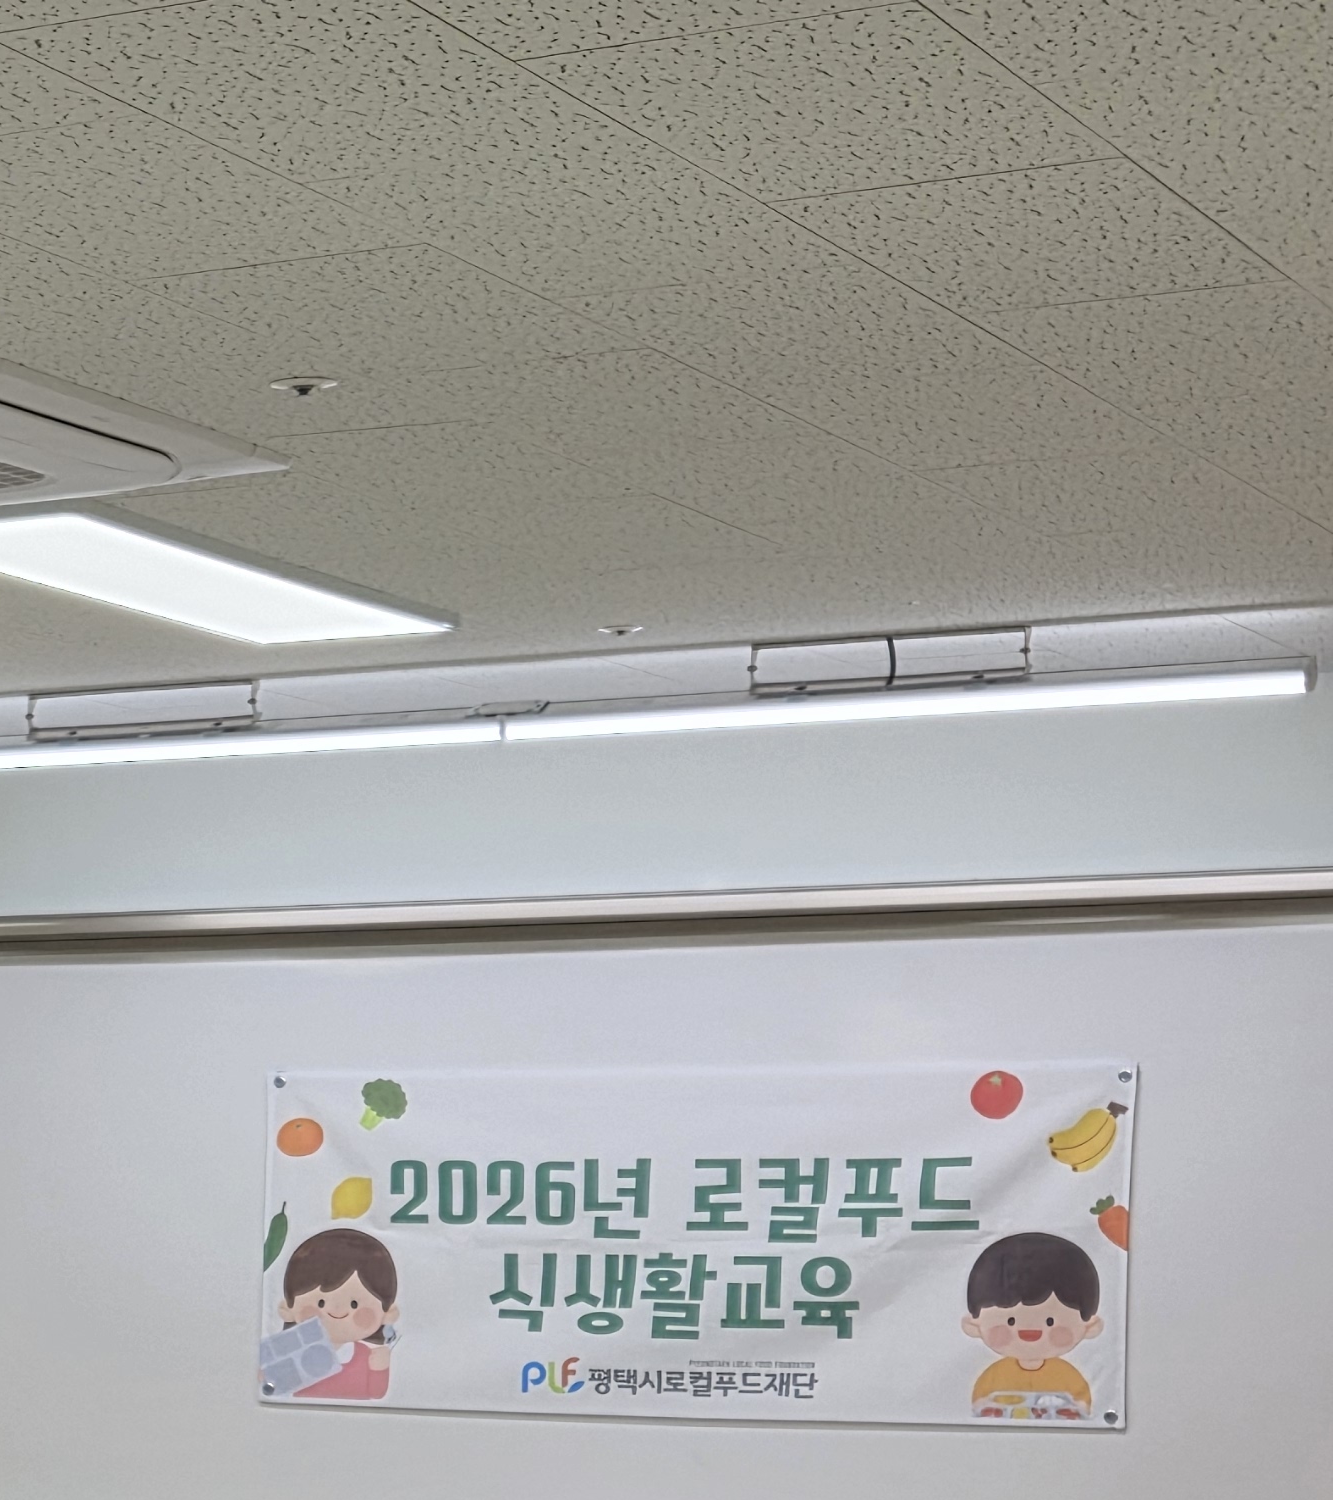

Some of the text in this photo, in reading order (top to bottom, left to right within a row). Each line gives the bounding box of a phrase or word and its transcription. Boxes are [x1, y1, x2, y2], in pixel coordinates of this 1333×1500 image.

[389, 1157, 980, 1243] 2026년 로컬푸드
[489, 1252, 860, 1340] 식생활교육
[588, 1367, 819, 1399] 평택시로컬푸드재단
